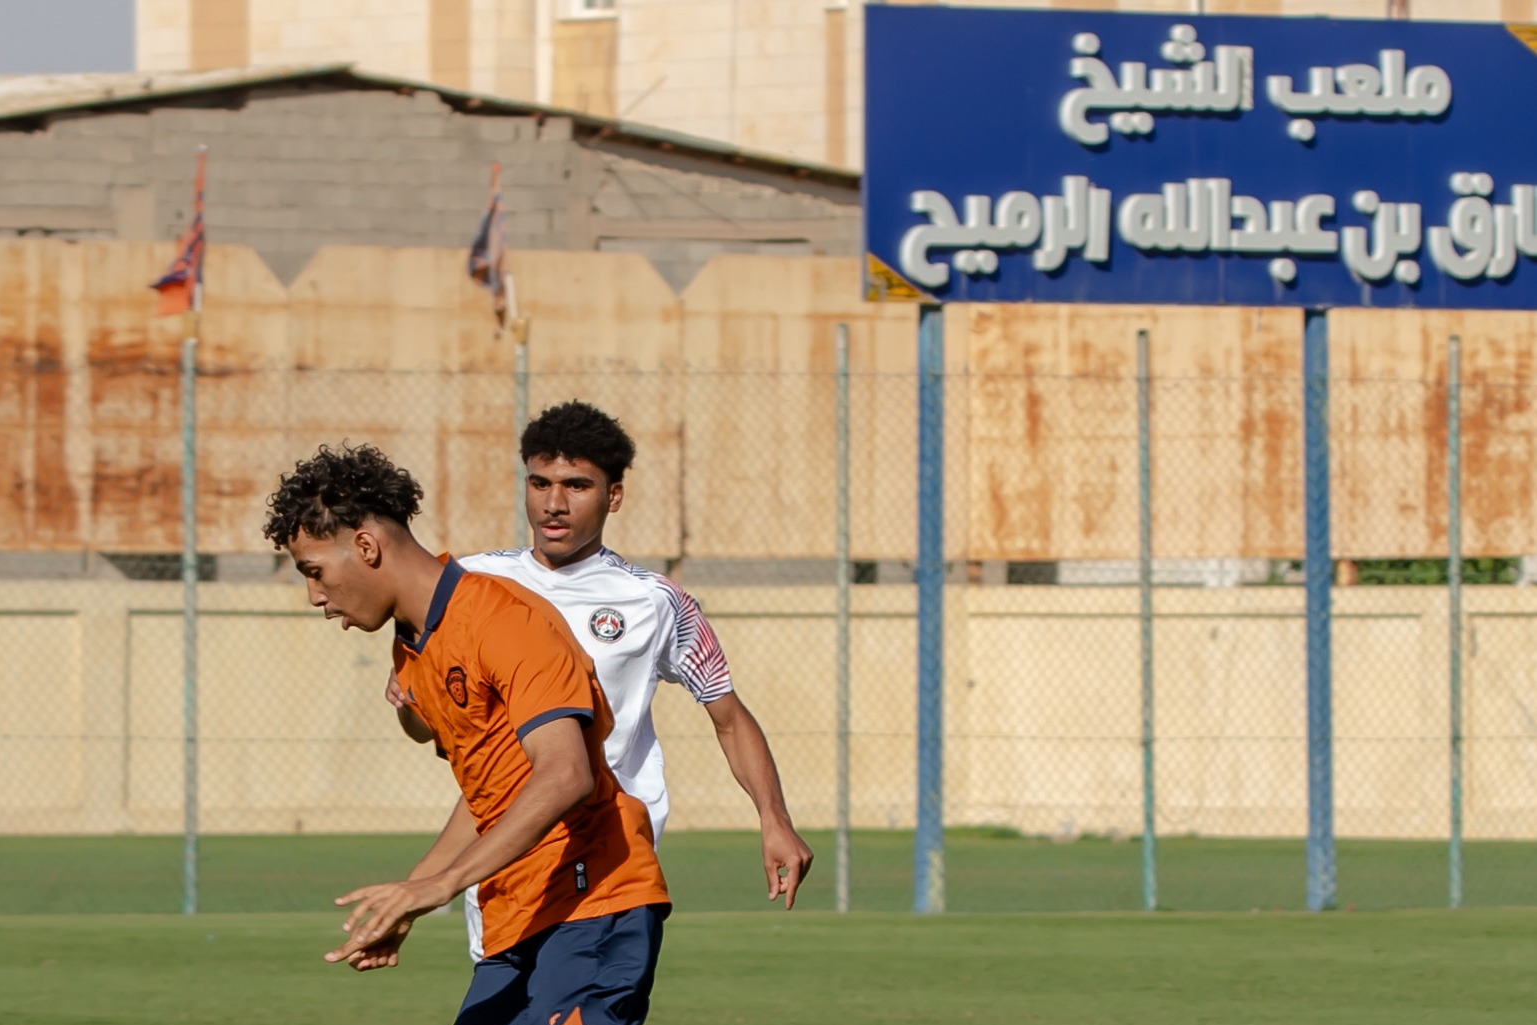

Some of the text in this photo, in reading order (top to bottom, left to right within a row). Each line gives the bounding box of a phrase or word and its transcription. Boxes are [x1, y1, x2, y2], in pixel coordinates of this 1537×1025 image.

[1059, 23, 1452, 144] ملعب الشيخ
[899, 171, 1537, 286] ارق بن عبدالله الرميح
